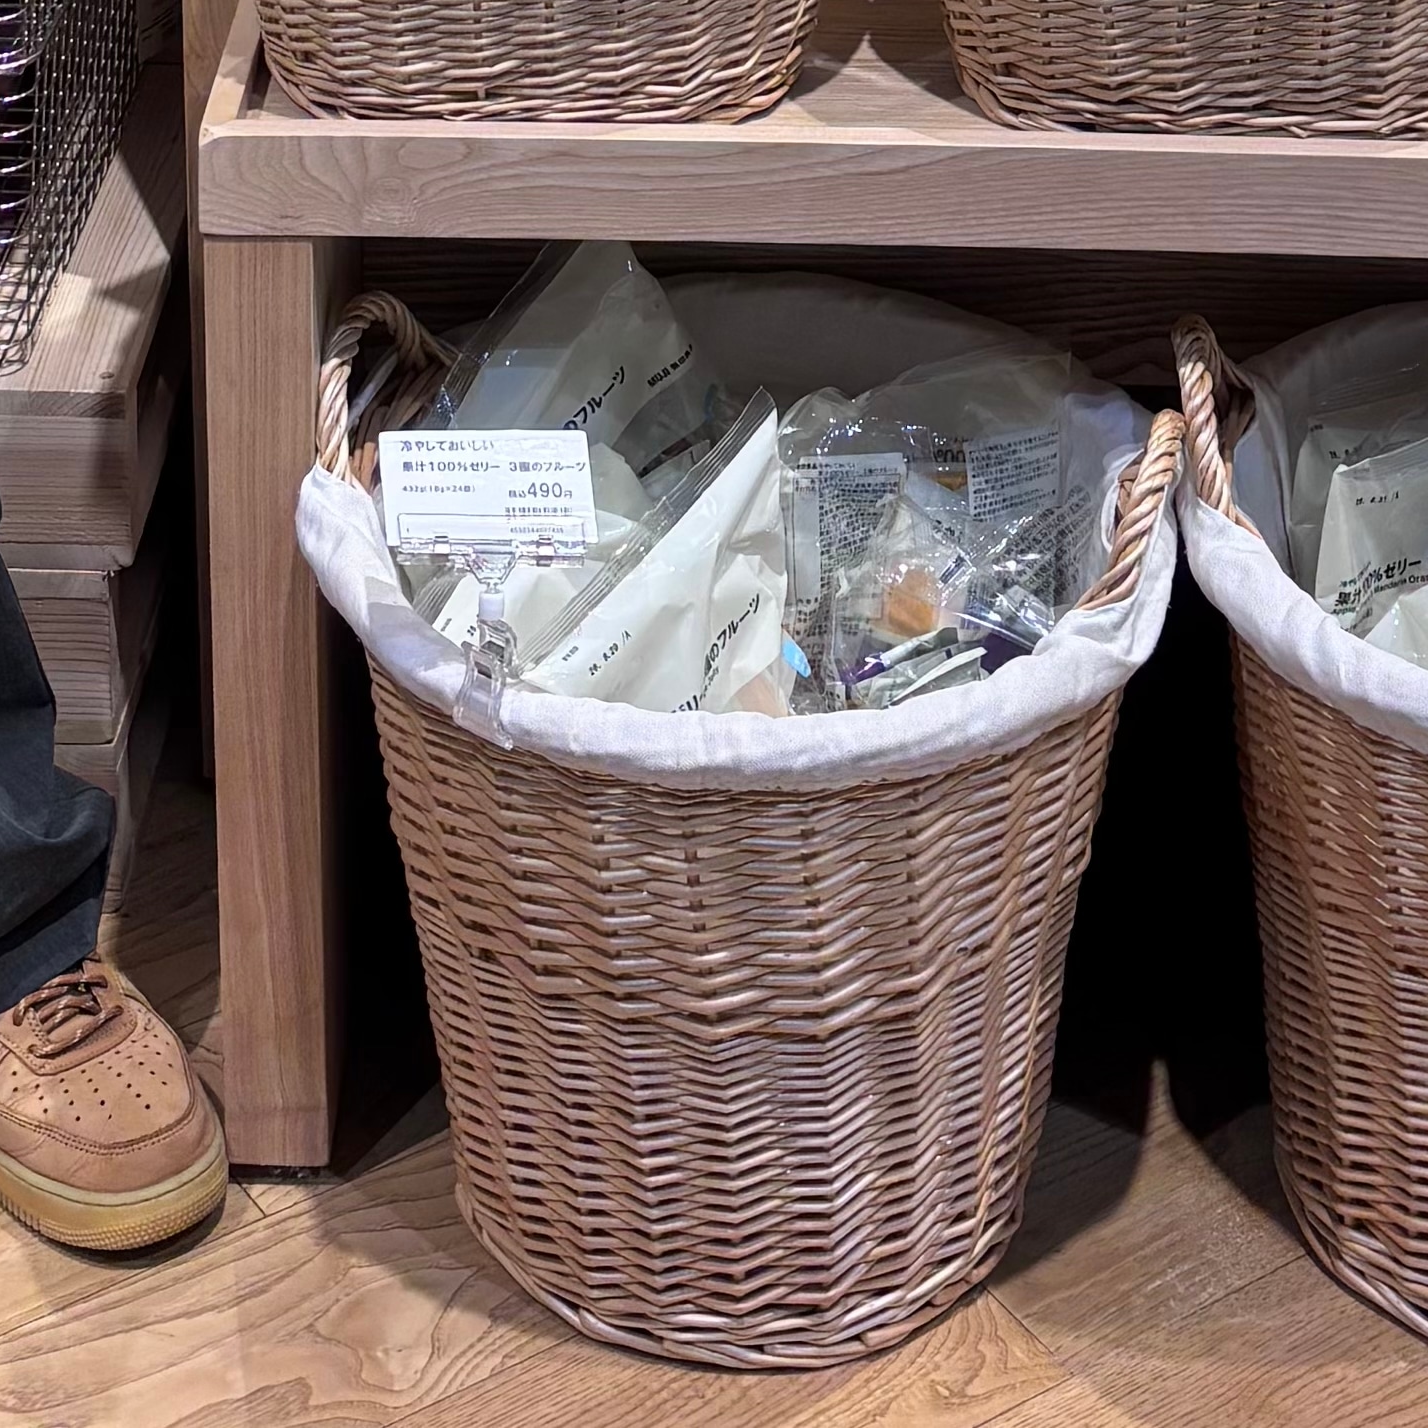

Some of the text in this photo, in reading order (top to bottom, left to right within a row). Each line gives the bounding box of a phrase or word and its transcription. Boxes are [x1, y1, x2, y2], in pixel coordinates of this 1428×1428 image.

[400, 440, 494, 452] 冷やしておいしい
[402, 462, 500, 472] 果汁100%ゼリー
[527, 482, 562, 498] 490
